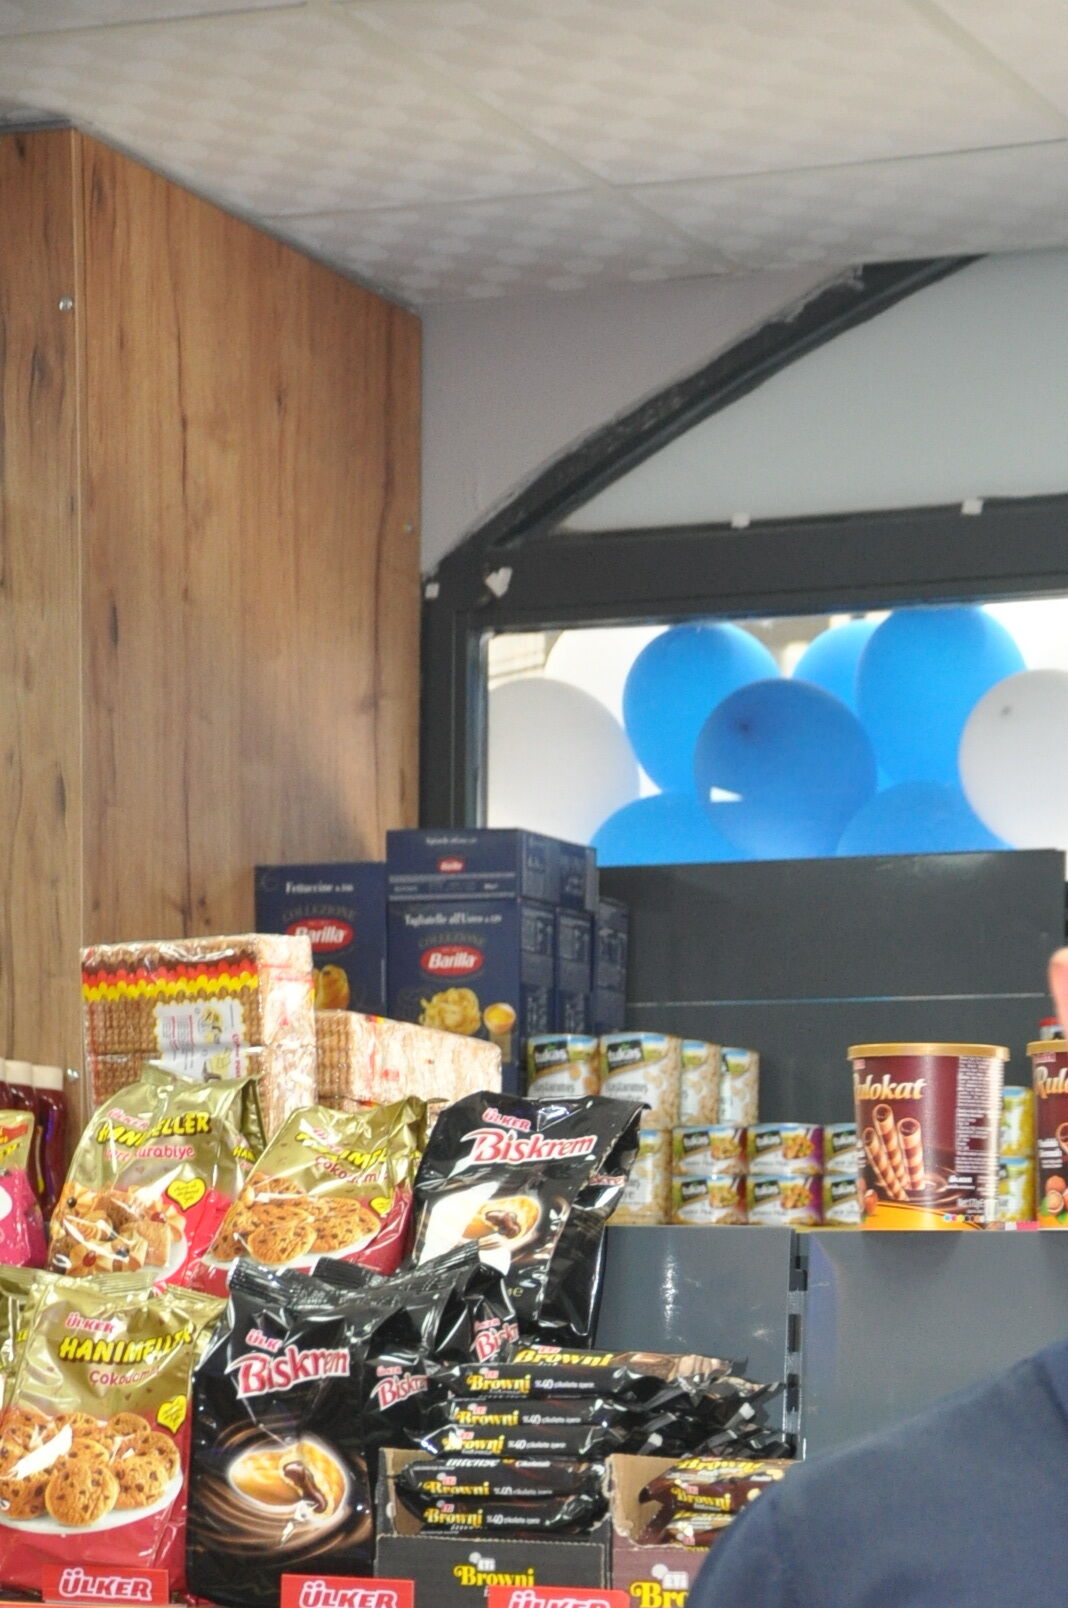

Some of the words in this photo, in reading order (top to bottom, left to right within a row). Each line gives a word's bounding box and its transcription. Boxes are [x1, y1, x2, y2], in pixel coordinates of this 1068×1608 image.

[427, 952, 478, 969] Barilla
[855, 1073, 927, 1101] ulokat
[482, 1107, 532, 1132] ÜLKER
[460, 1127, 598, 1166] Biskrem
[245, 1329, 283, 1353] ÜLK
[512, 1348, 615, 1367] Browni
[225, 1345, 350, 1399] Biskrem
[466, 1374, 532, 1394] Browni
[455, 1409, 520, 1426] Browni
[423, 1508, 484, 1528] Browni
[58, 1566, 153, 1602] ÜLKER
[453, 1564, 536, 1587] Browni
